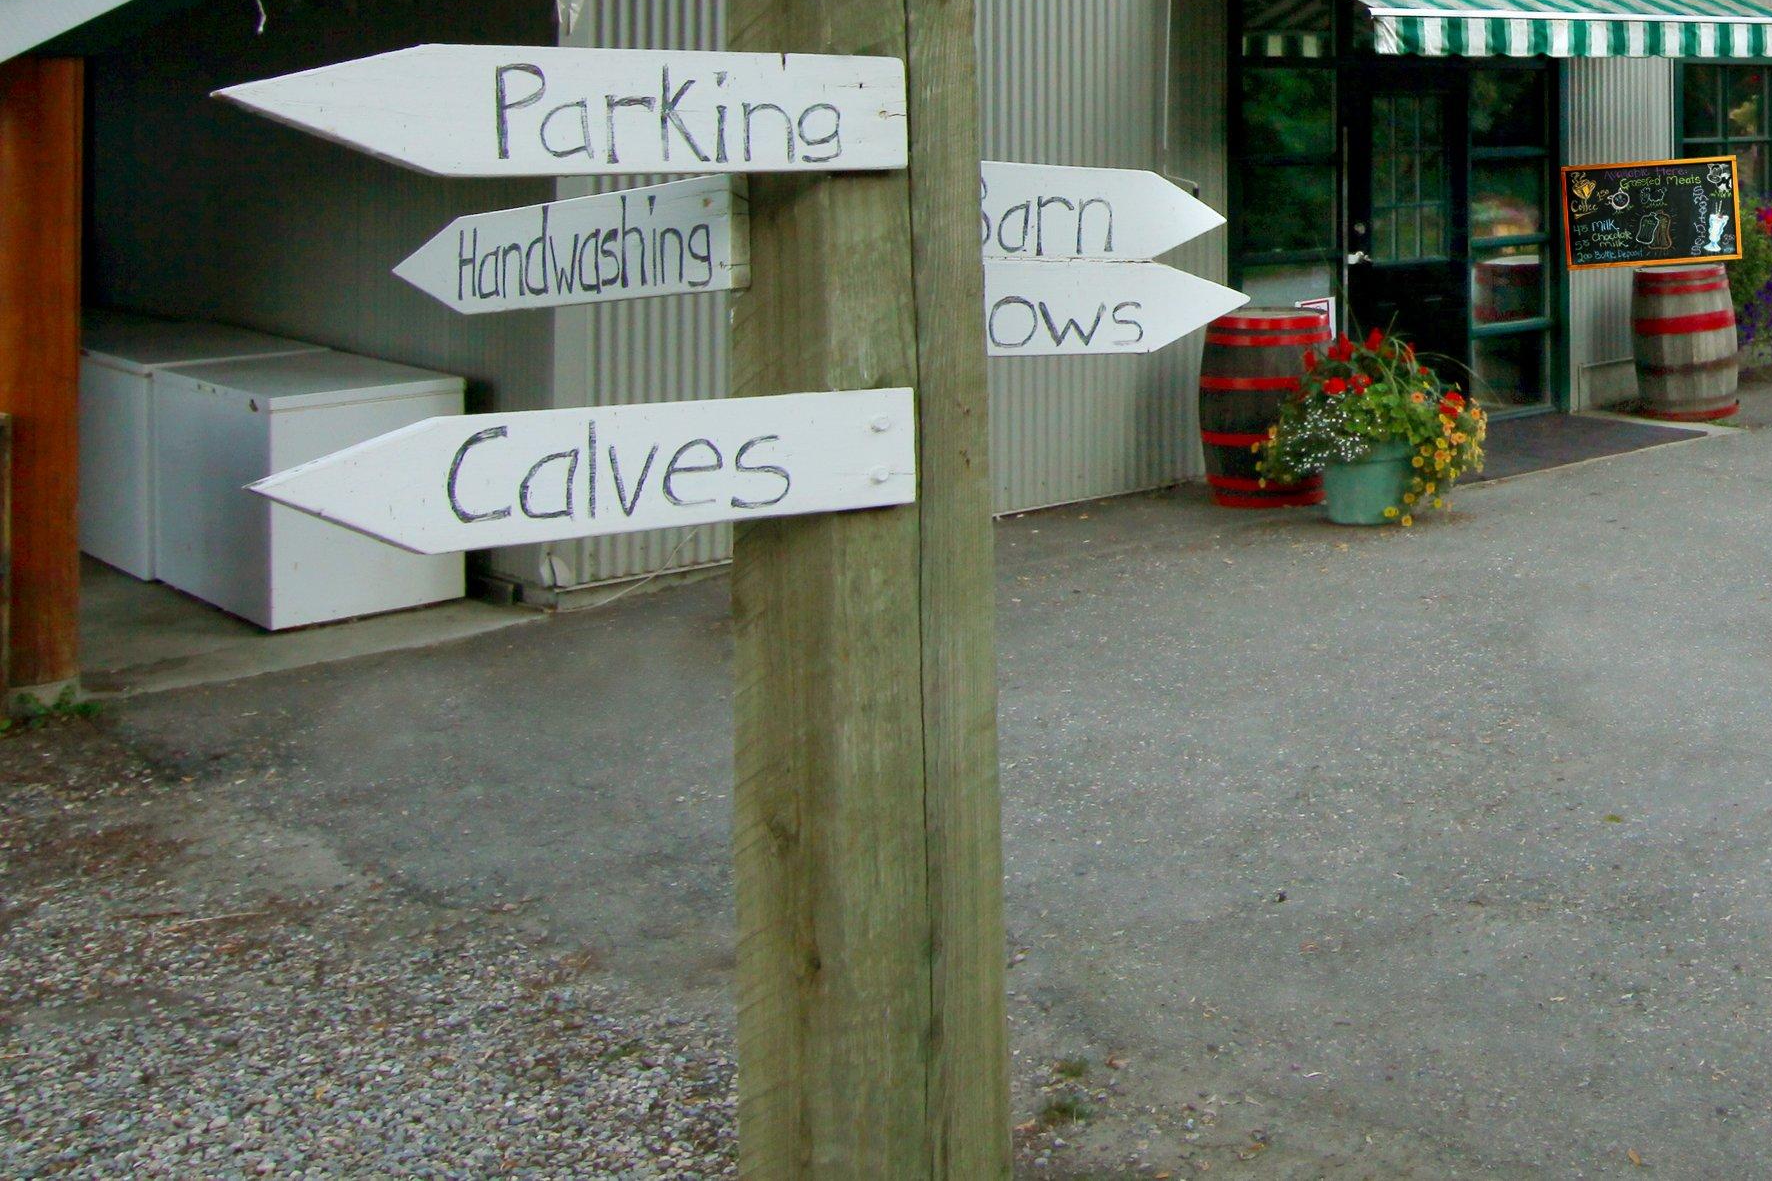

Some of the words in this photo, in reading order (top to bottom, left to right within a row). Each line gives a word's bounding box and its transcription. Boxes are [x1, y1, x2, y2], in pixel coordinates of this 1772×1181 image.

[495, 62, 843, 165] Parking
[1666, 174, 1702, 186] Meats
[458, 194, 713, 301] Handwashing
[988, 295, 1144, 349] ows
[447, 419, 792, 524] Calves
